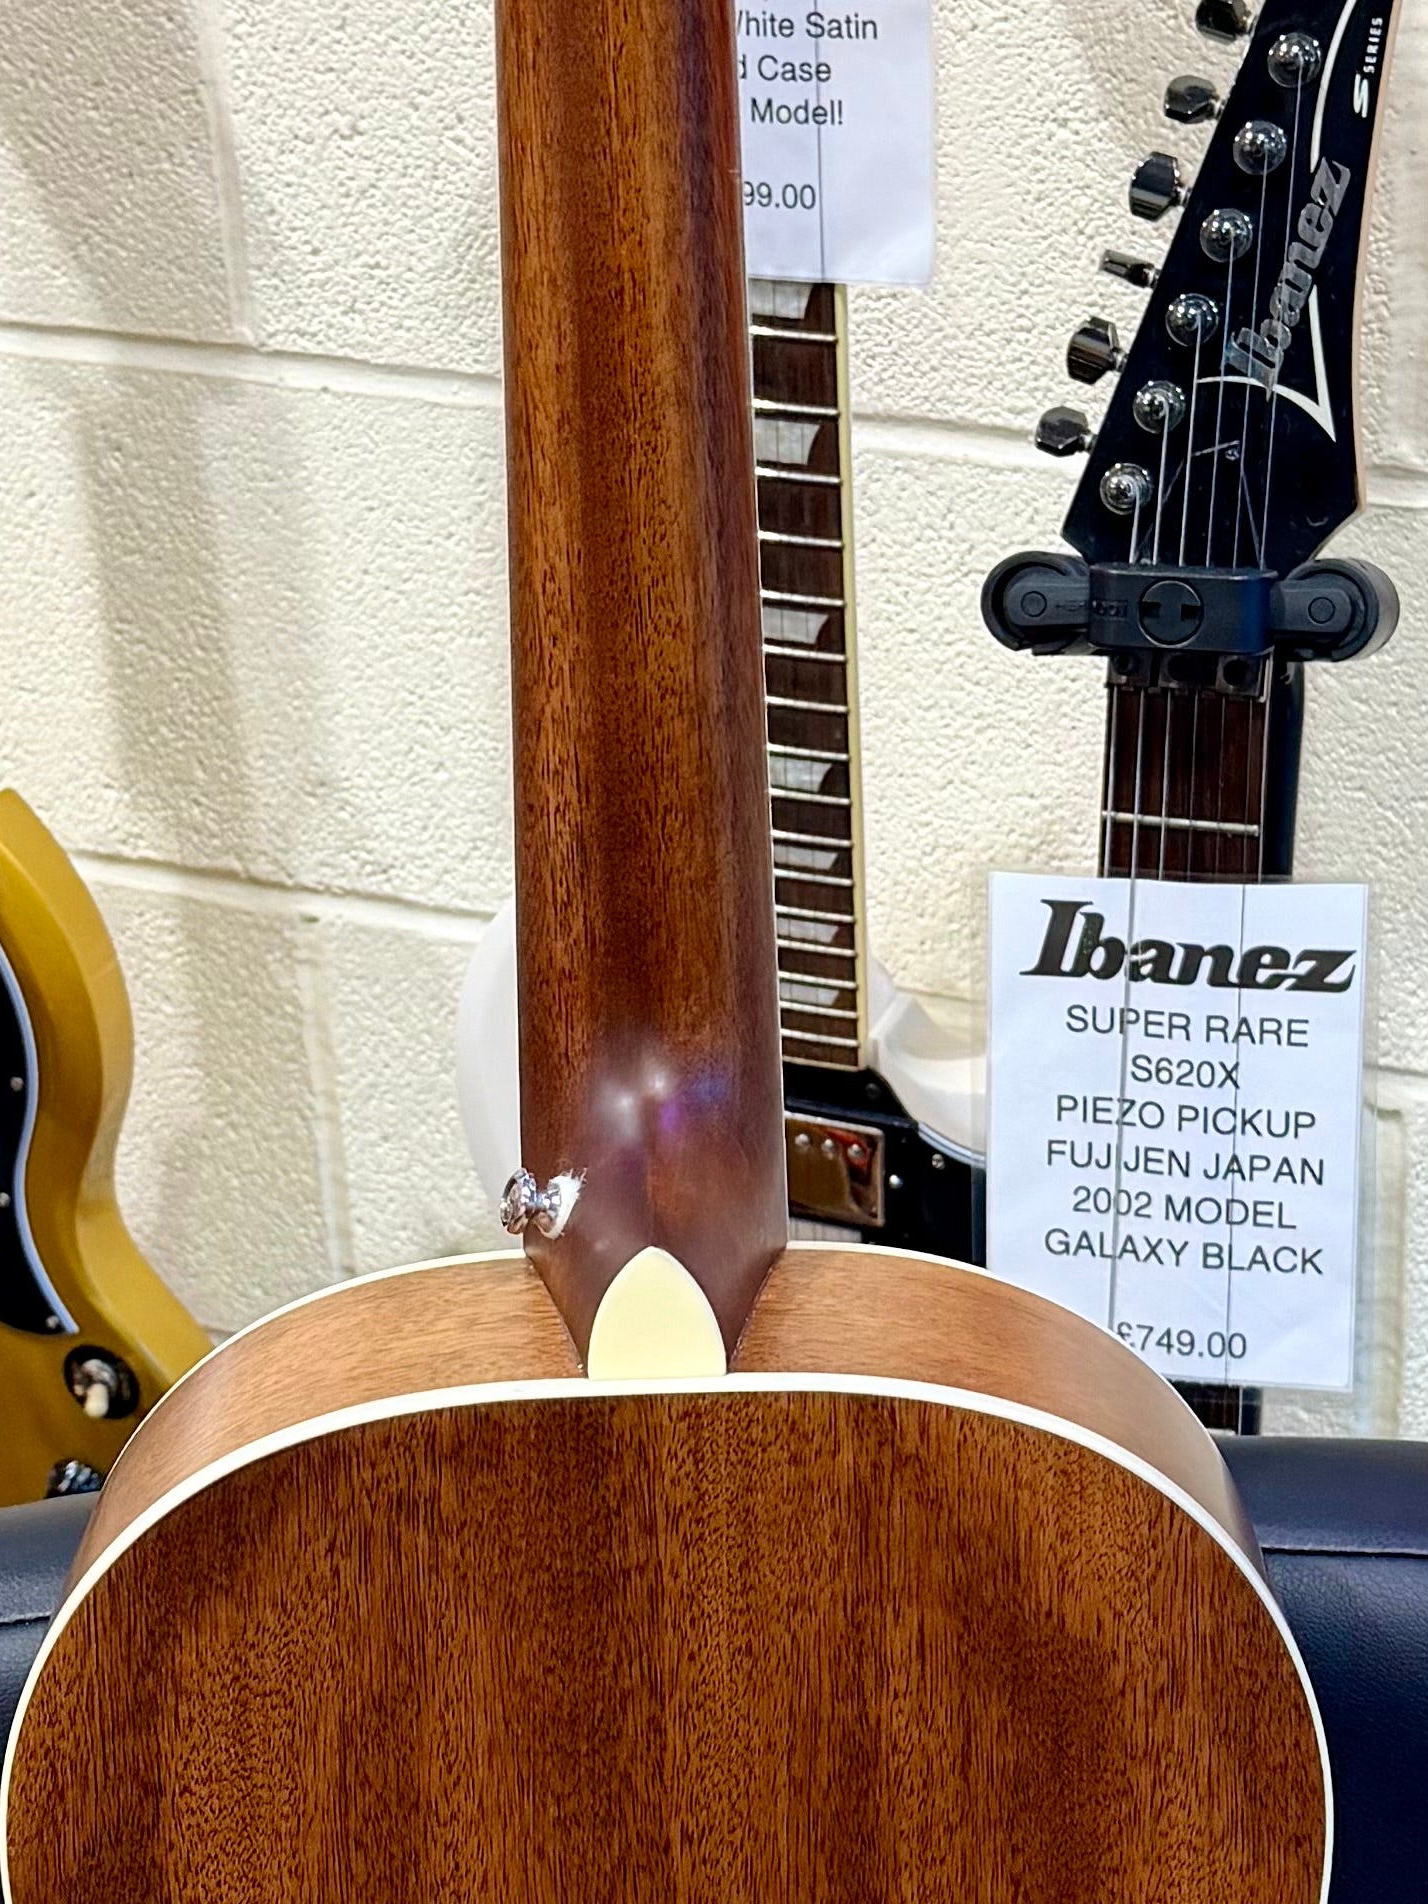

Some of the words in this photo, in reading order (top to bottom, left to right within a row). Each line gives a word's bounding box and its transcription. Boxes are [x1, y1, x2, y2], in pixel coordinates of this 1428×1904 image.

[805, 11, 878, 40] Satin
[757, 54, 832, 82] Case
[1353, 73, 1369, 118] S
[1362, 17, 1383, 74] SERIES
[750, 97, 844, 125] Model!
[1223, 156, 1351, 403] Ibanez
[1018, 898, 1357, 993] Ibanez
[1065, 1004, 1191, 1042] SUPER
[1205, 1015, 1310, 1048] RARE
[1130, 1055, 1241, 1089] S620X
[1056, 1094, 1166, 1130] PIEZO
[1177, 1104, 1317, 1139] PICKUP
[1046, 1139, 1190, 1178] FUJJEN
[1203, 1153, 1325, 1186] JAPAN
[1072, 1185, 1152, 1219] 2002
[1164, 1196, 1298, 1230] MODEL
[1044, 1229, 1189, 1268] GALAXY
[1202, 1243, 1324, 1275] BLACK
[1117, 1321, 1247, 1359] £749.00
